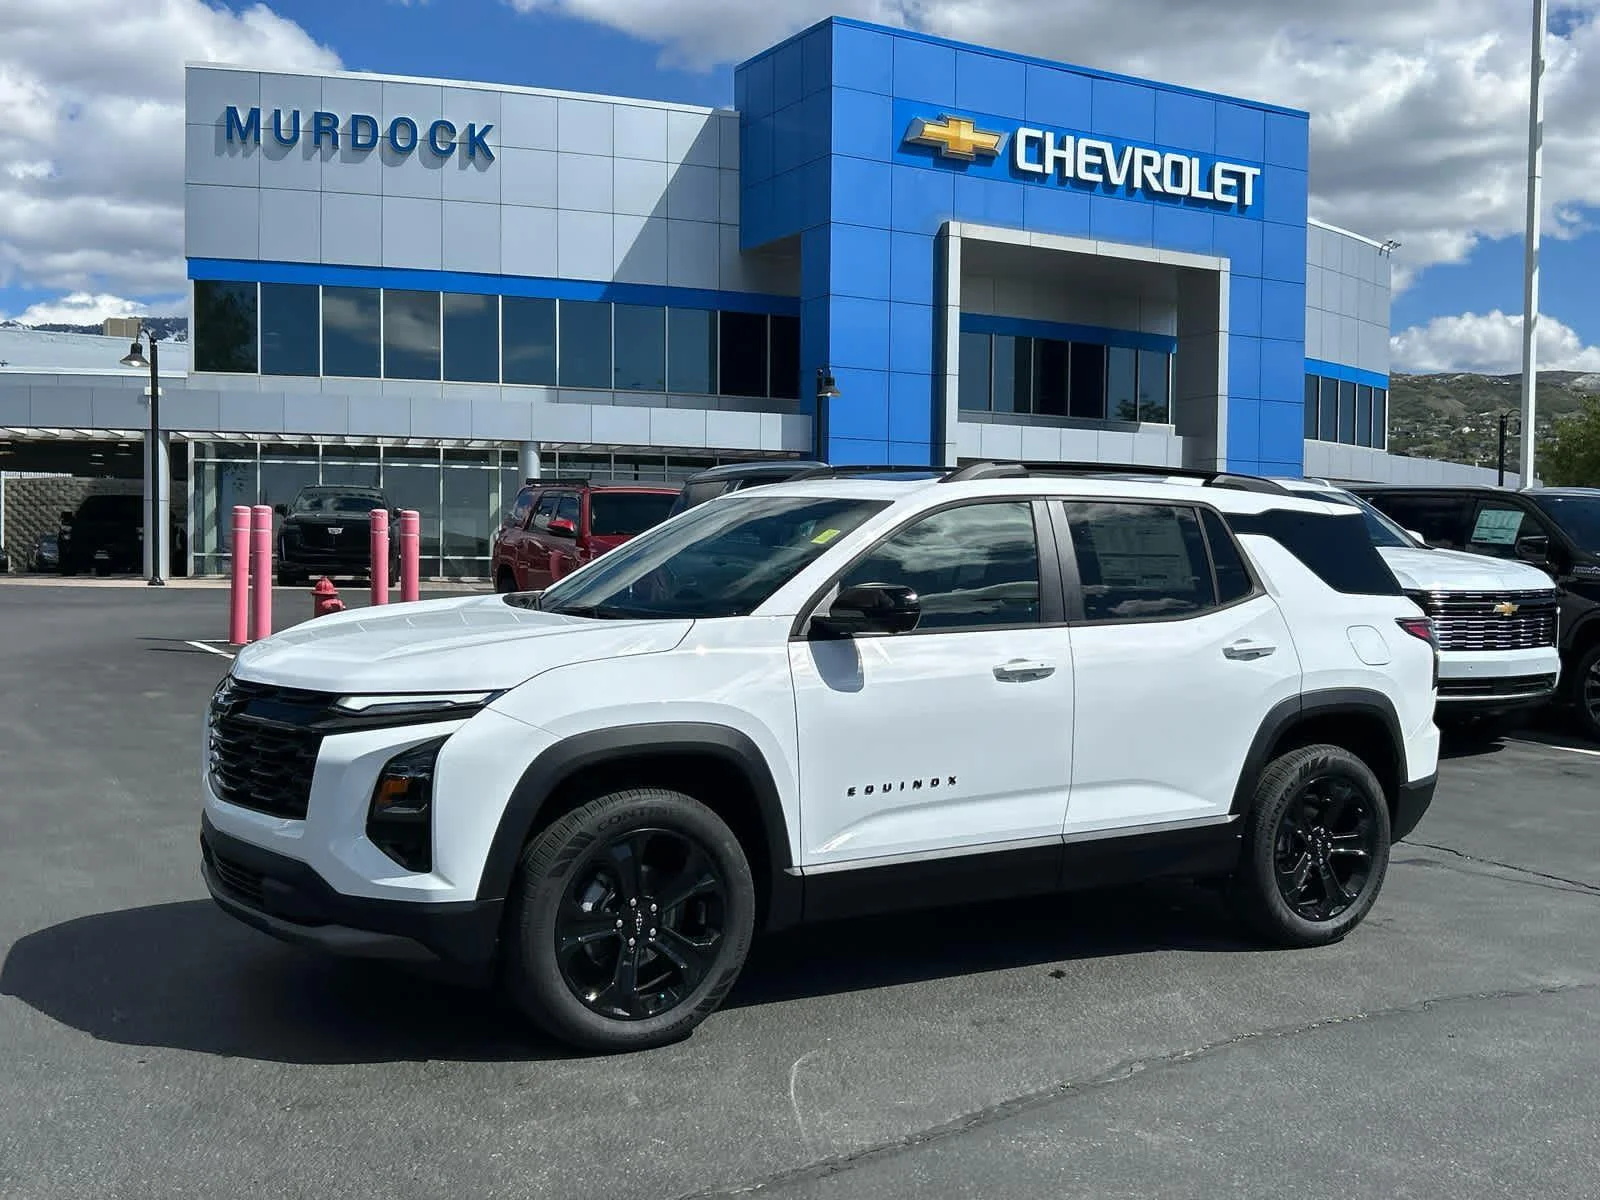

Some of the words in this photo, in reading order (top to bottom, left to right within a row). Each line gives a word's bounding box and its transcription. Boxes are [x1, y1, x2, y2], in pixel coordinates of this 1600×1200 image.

[226, 105, 495, 161] MURDOCK
[1016, 127, 1261, 206] CHEVROLET
[847, 775, 957, 797] EQUINOX
